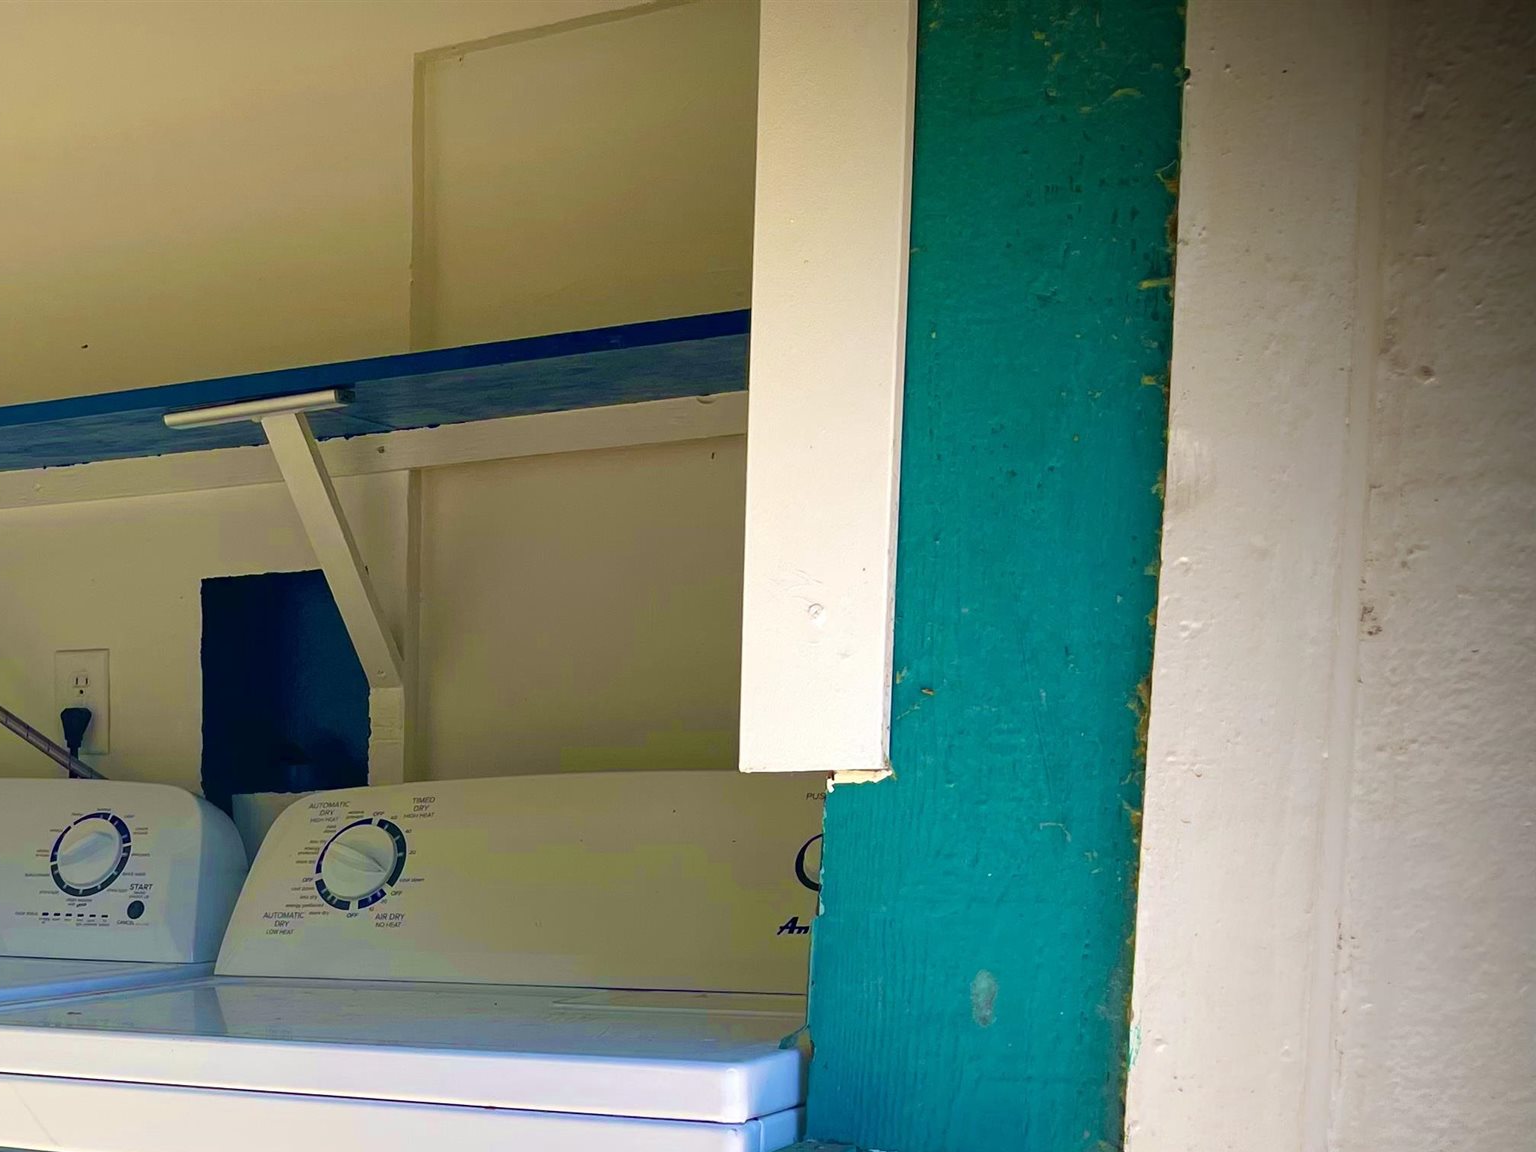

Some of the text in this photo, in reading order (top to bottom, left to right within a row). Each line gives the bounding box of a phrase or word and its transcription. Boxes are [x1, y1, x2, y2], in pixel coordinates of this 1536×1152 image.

[806, 792, 826, 801] PUS
[309, 801, 351, 809] AUTOMATIC
[413, 804, 430, 812] DRY
